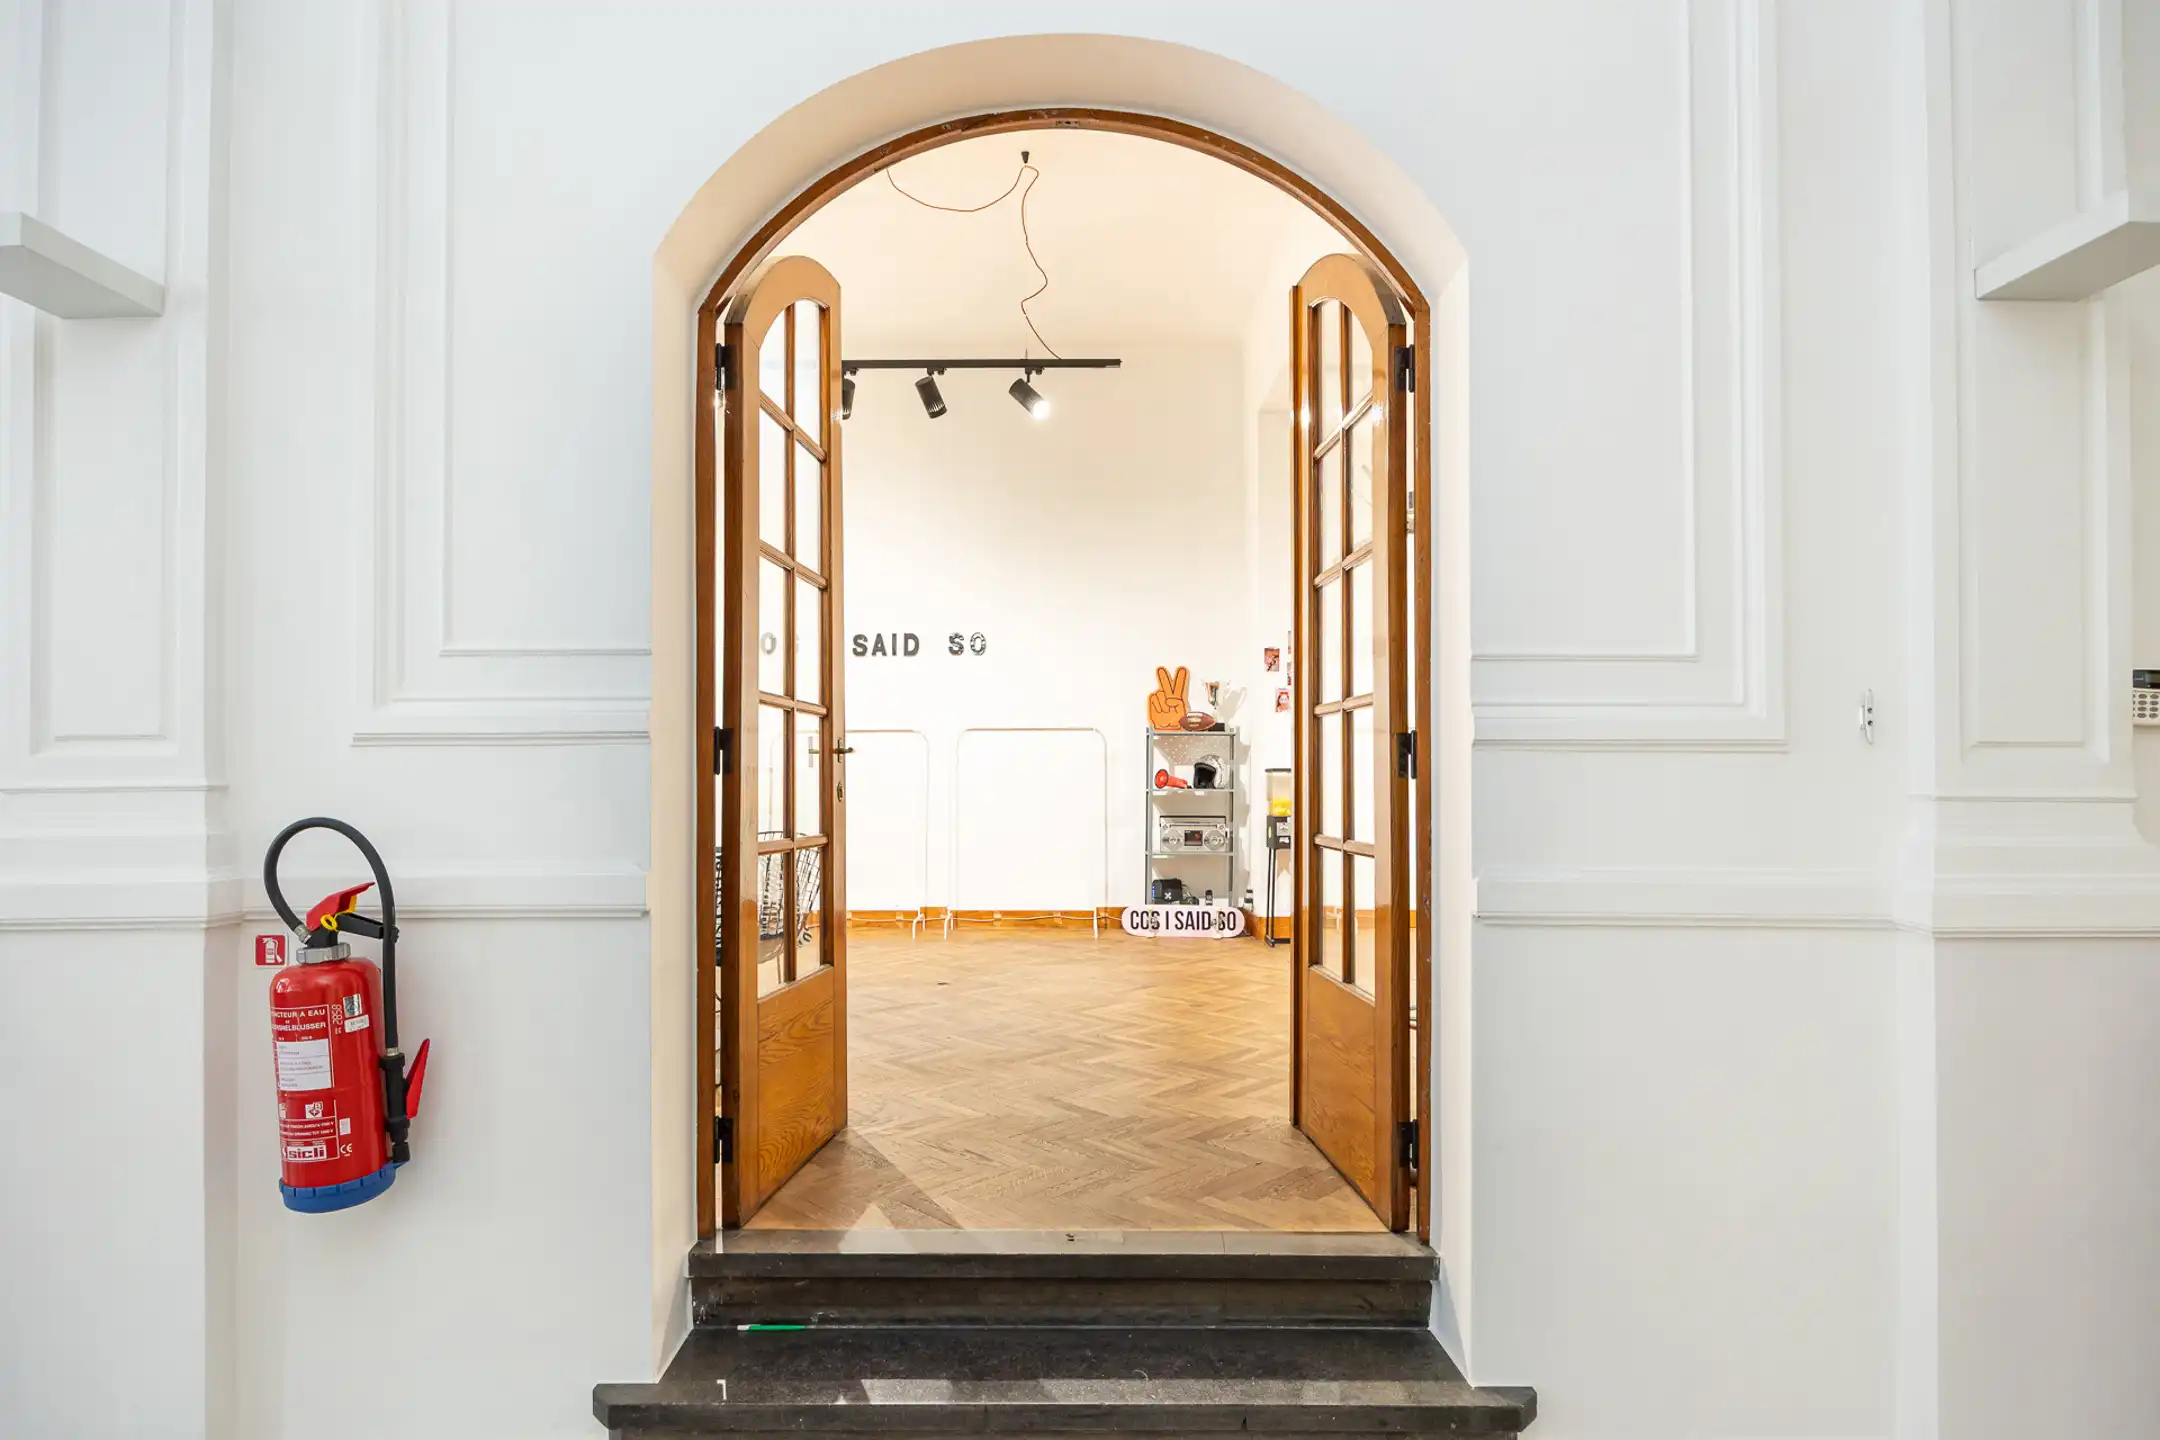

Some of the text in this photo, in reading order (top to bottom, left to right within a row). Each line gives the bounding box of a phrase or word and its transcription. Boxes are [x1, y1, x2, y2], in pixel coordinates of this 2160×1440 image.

[852, 632, 987, 656] SAID SO
[1165, 911, 1169, 930] I
[1174, 911, 1211, 930] SAID
[1217, 911, 1236, 931] SO
[308, 1009, 325, 1017] EAU
[289, 1147, 325, 1159] sicli
